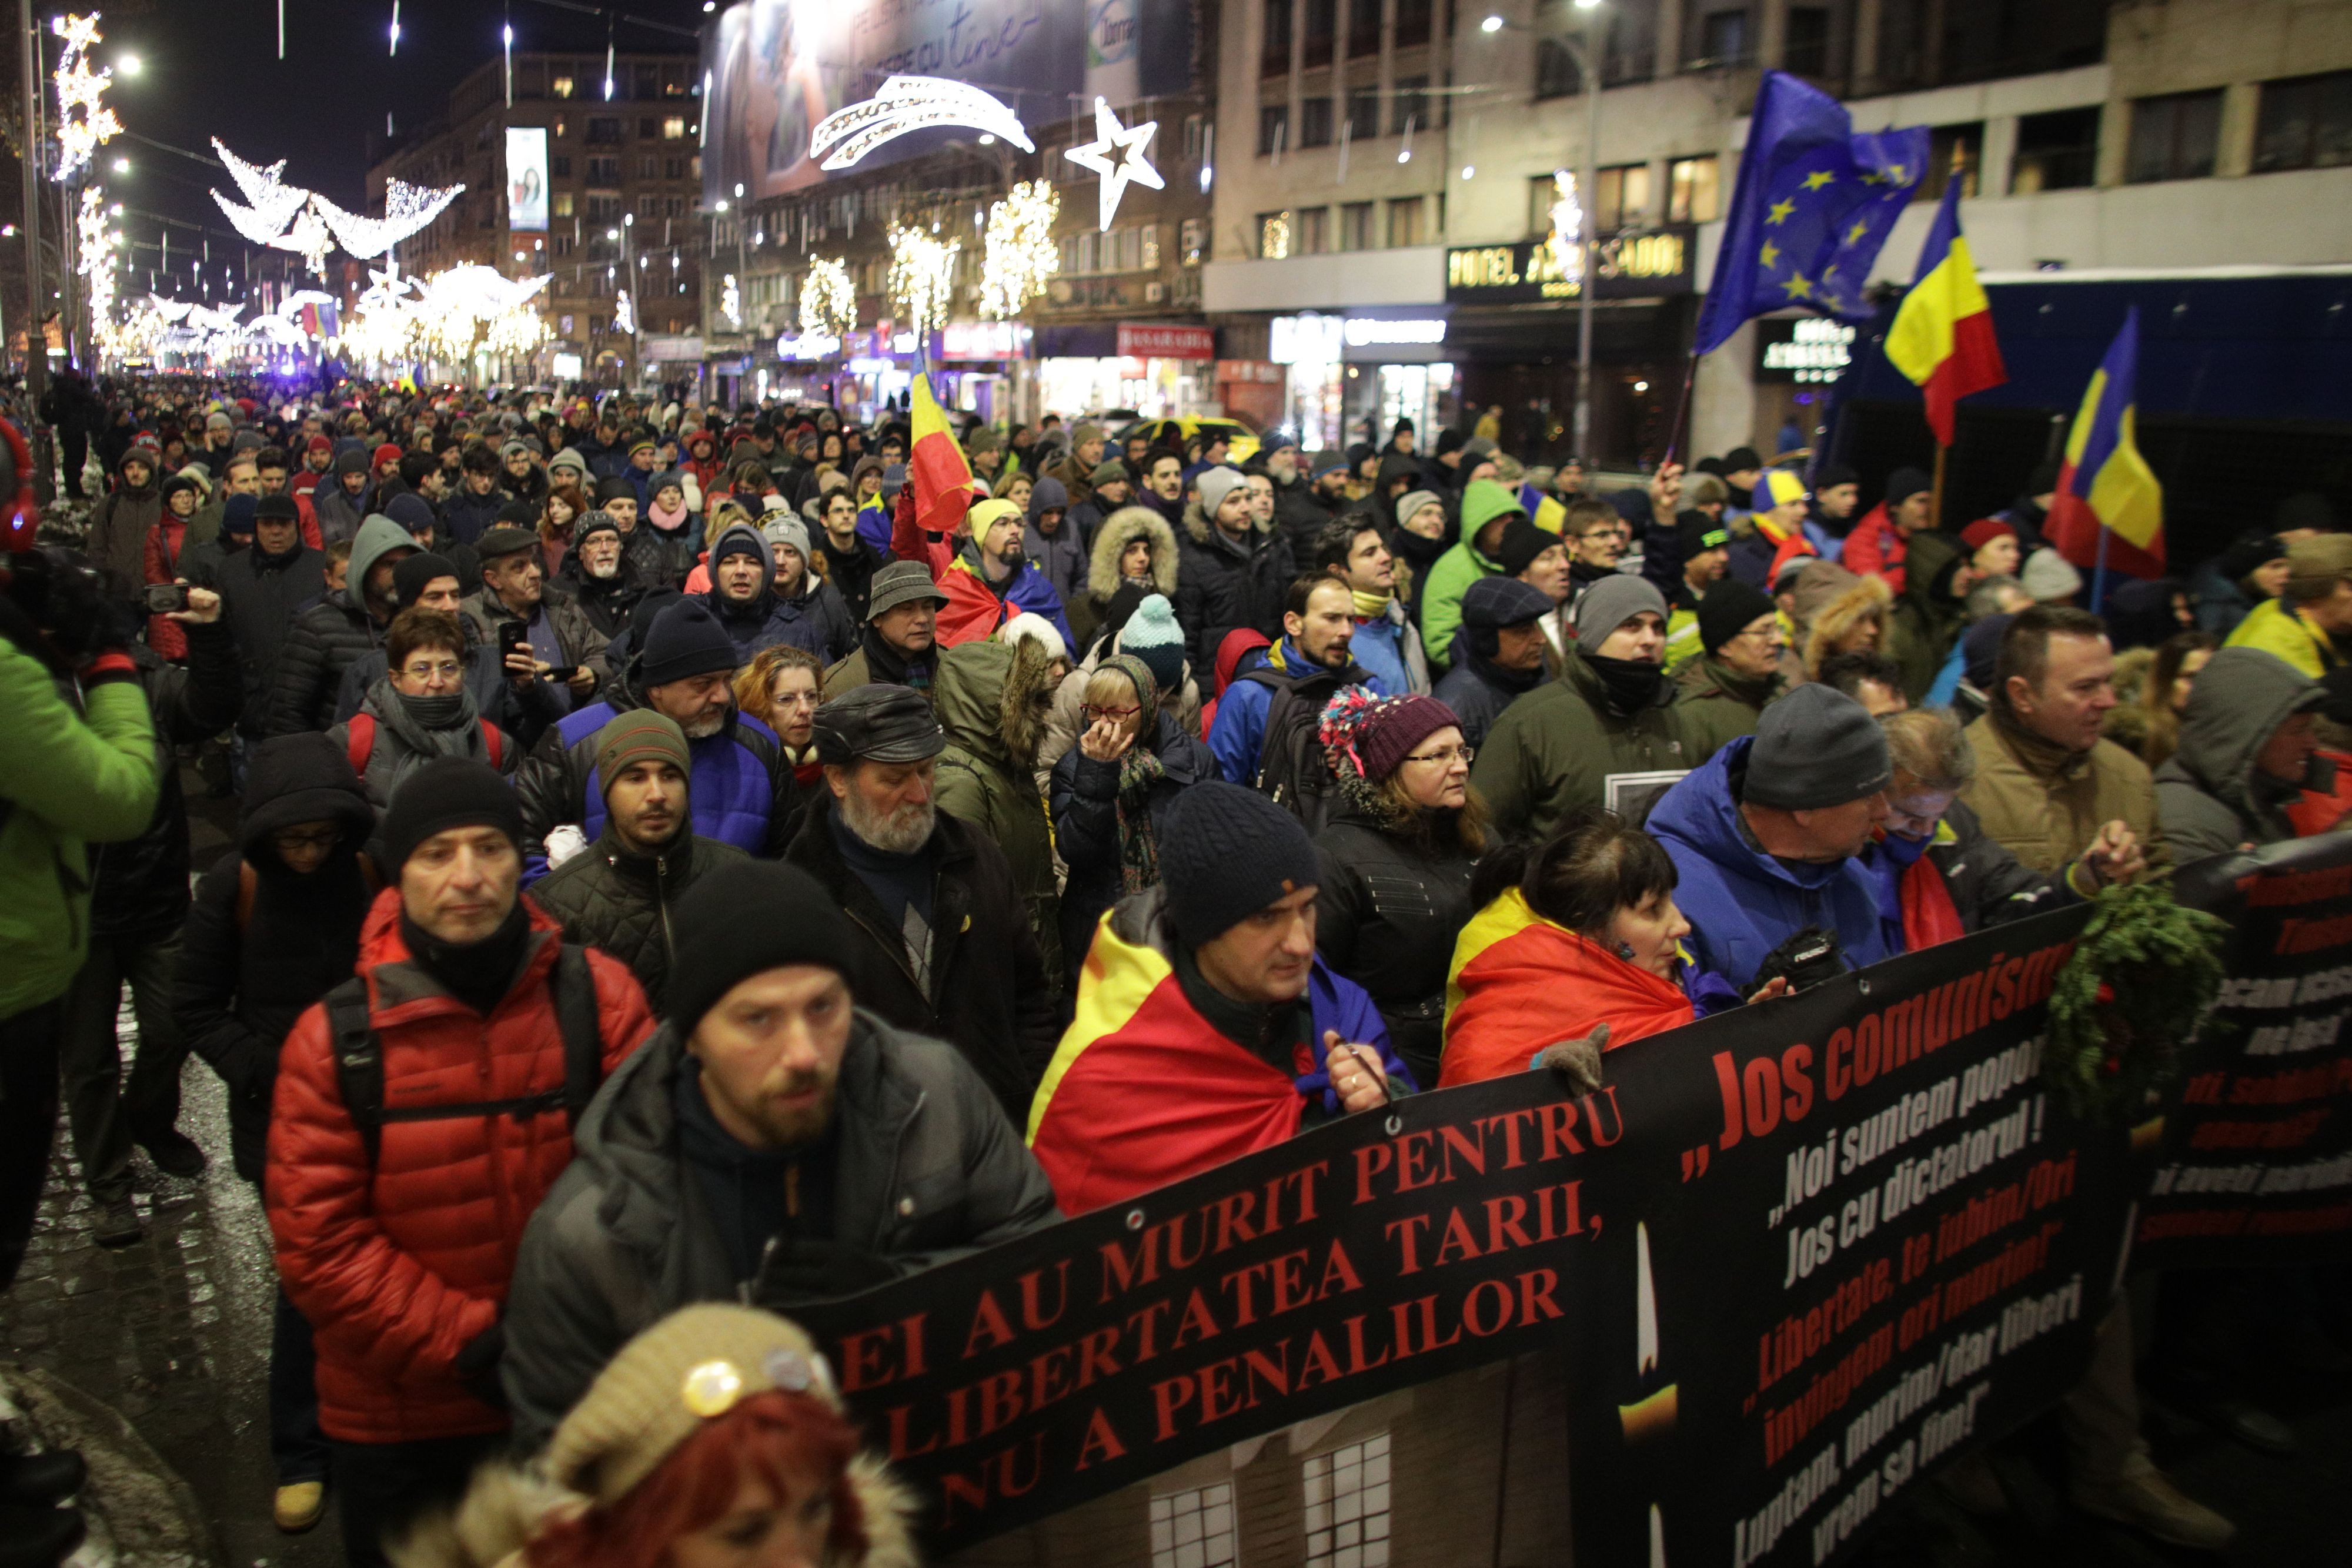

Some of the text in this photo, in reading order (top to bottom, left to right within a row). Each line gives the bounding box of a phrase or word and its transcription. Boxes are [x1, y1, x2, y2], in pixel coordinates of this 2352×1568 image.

[1449, 247, 1520, 287] HOTEL
[1784, 1215, 1835, 1290] Jos
[1838, 1186, 1880, 1249] cu
[1881, 1098, 2030, 1222] dictatorul
[1840, 1075, 1957, 1176] suntem
[842, 1084, 1625, 1393] EI AU MURIT PENTRU
[1901, 1232, 1932, 1285] te
[1999, 1273, 2083, 1356] liberi
[886, 1179, 1603, 1462] LIBERTATEA TARII,
[1764, 1320, 1894, 1467] invingem
[1898, 1283, 1941, 1352] ori
[941, 1268, 1565, 1530] NU A PENALILOR
[1813, 1469, 1880, 1566] vrem
[1881, 1439, 1916, 1498] sa
